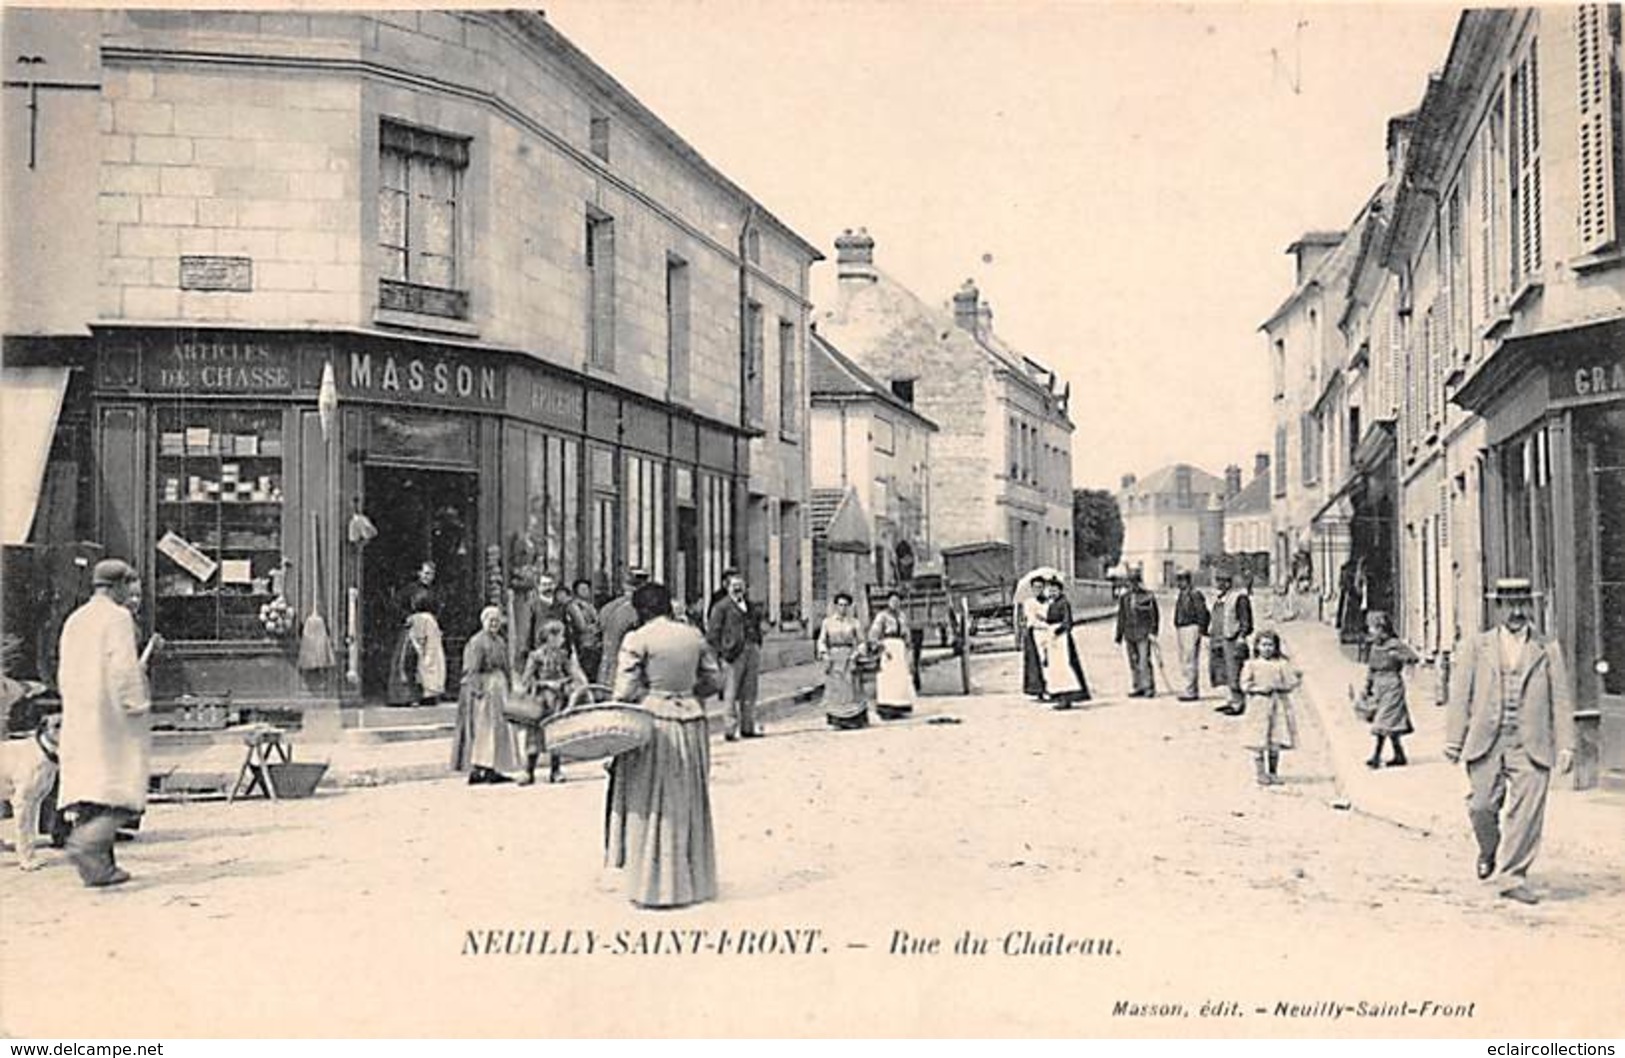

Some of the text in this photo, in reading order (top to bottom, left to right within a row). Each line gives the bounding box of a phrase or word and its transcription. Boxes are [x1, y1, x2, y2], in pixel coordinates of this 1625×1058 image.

[171, 343, 269, 361] ARTICLES
[160, 366, 290, 389] DE CHASSE
[350, 352, 495, 399] MASSON
